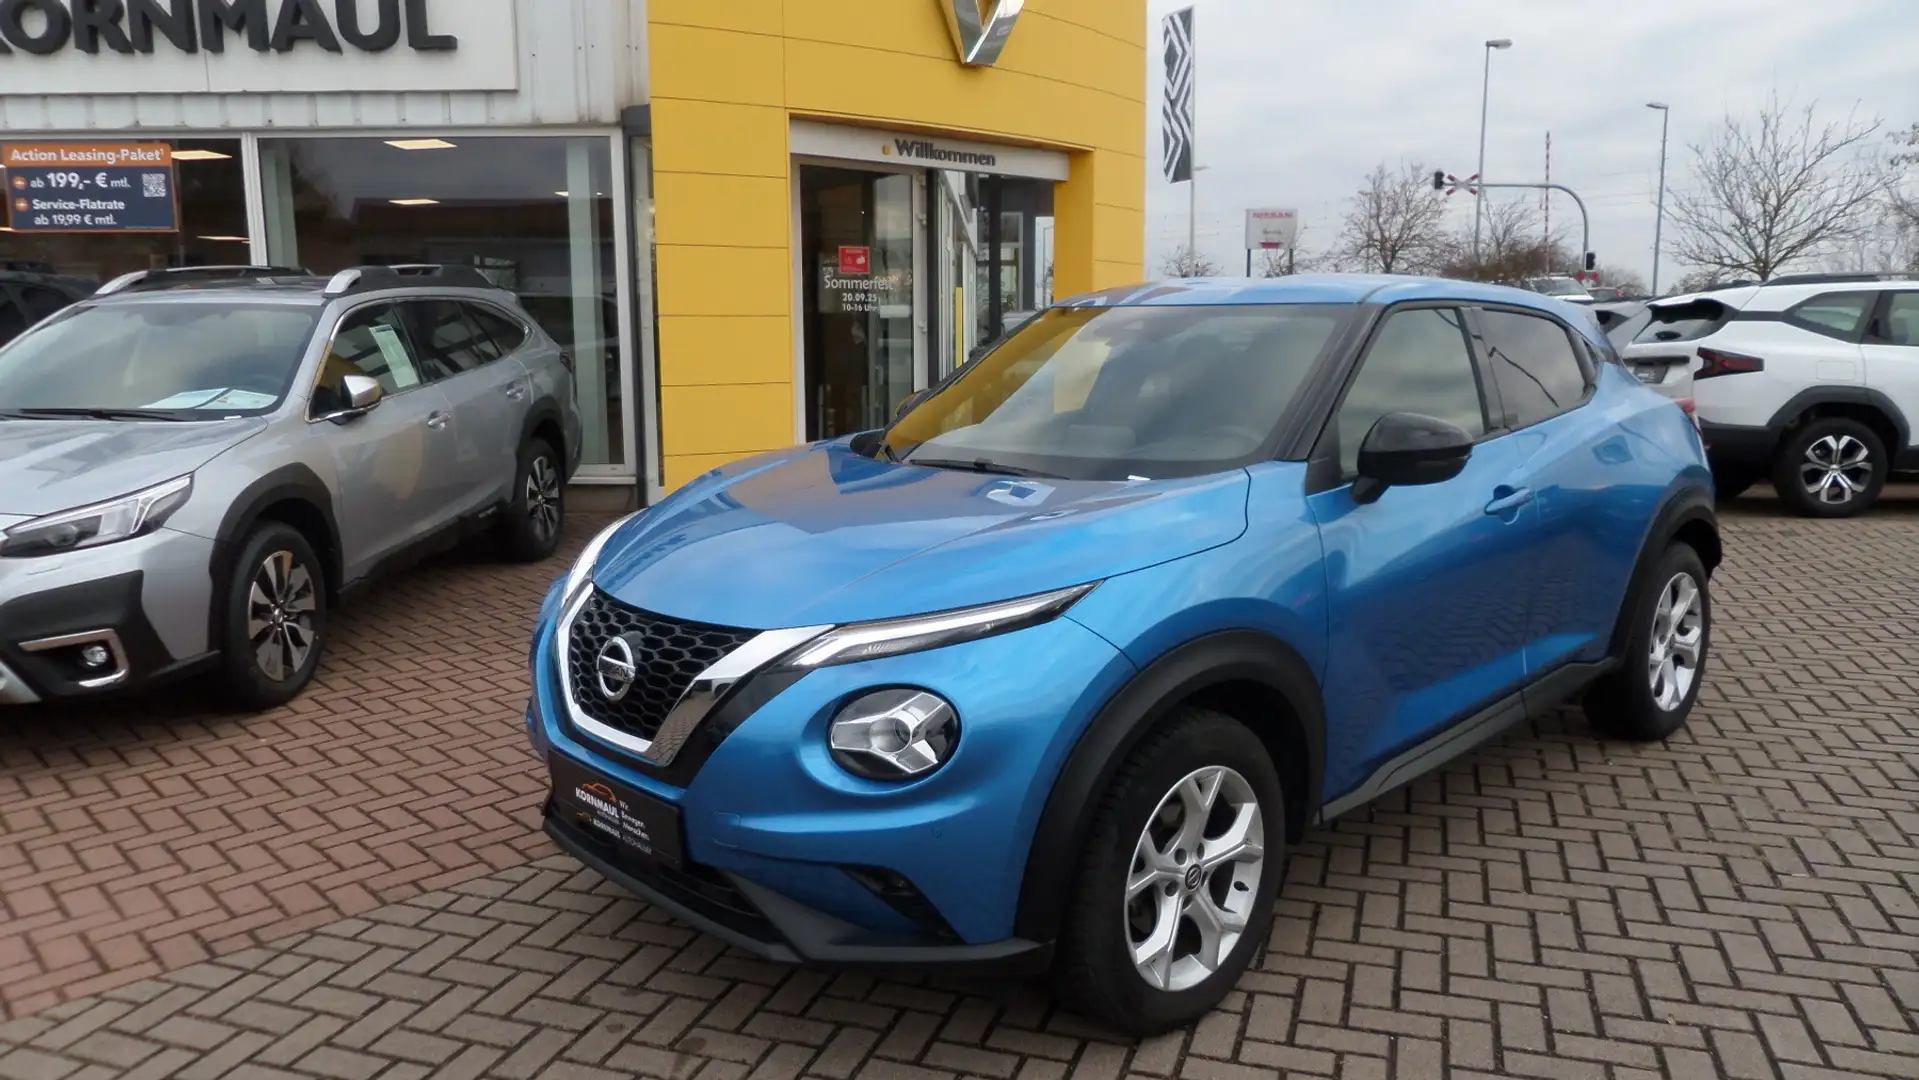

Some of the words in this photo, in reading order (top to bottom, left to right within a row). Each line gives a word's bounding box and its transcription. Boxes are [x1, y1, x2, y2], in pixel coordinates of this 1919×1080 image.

[0, 0, 458, 54] ORNMAUL
[10, 149, 57, 161] Action
[894, 139, 996, 166] Willkommen
[30, 177, 45, 188] ab
[95, 172, 108, 188] €
[110, 177, 131, 188] mtl.
[32, 198, 125, 210] Service-Flatrate
[34, 214, 49, 225] ab
[84, 214, 93, 225] €
[575, 786, 620, 818] KORNMAUL
